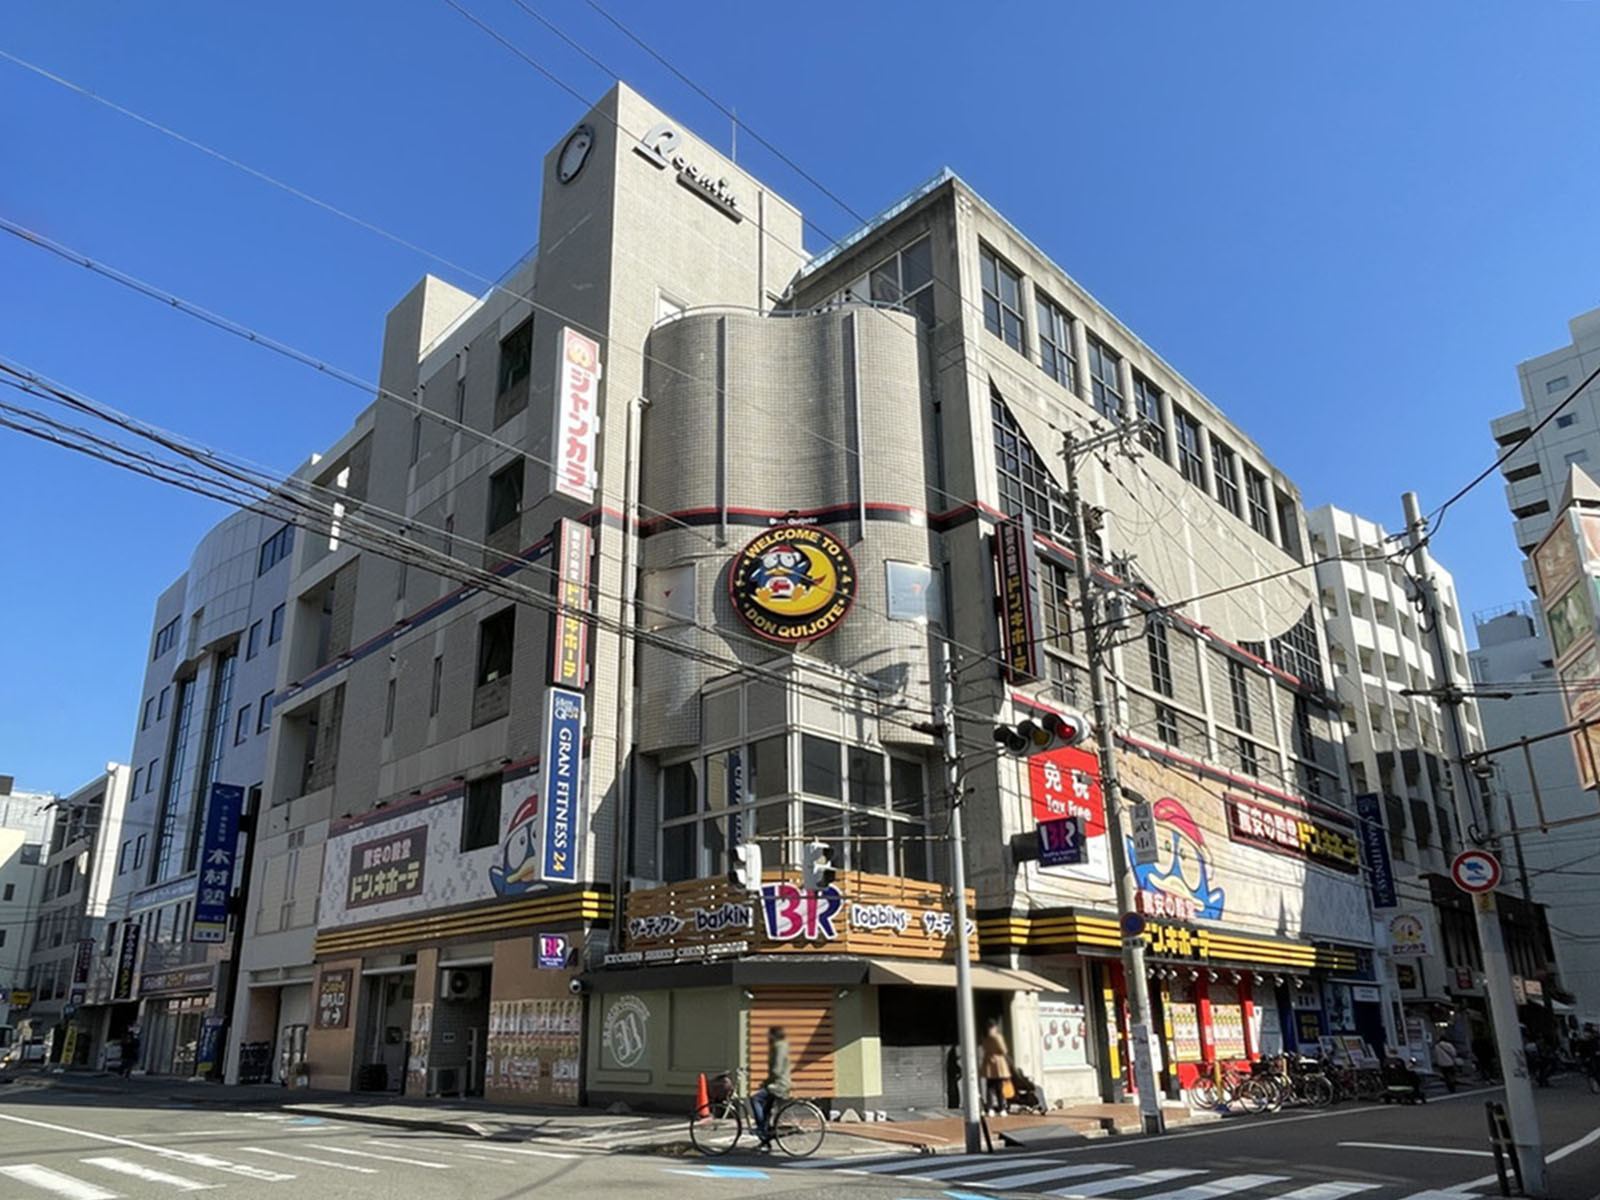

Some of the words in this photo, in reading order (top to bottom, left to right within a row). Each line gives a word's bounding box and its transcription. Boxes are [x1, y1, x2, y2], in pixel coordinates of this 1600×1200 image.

[566, 367, 590, 487] ジャンカラ
[745, 528, 822, 559] WELCOME
[822, 537, 841, 556] TO
[745, 607, 777, 634] DON
[777, 603, 845, 638] QUIJOTE
[558, 726, 573, 777] GRAN
[553, 780, 570, 849] FITNESS
[1045, 793, 1066, 815] Tax
[1067, 799, 1093, 822] Free
[552, 852, 567, 873] 24
[630, 916, 683, 938] サーティワン
[760, 884, 843, 939] BR
[853, 905, 906, 931] robbins
[540, 937, 565, 957] BR
